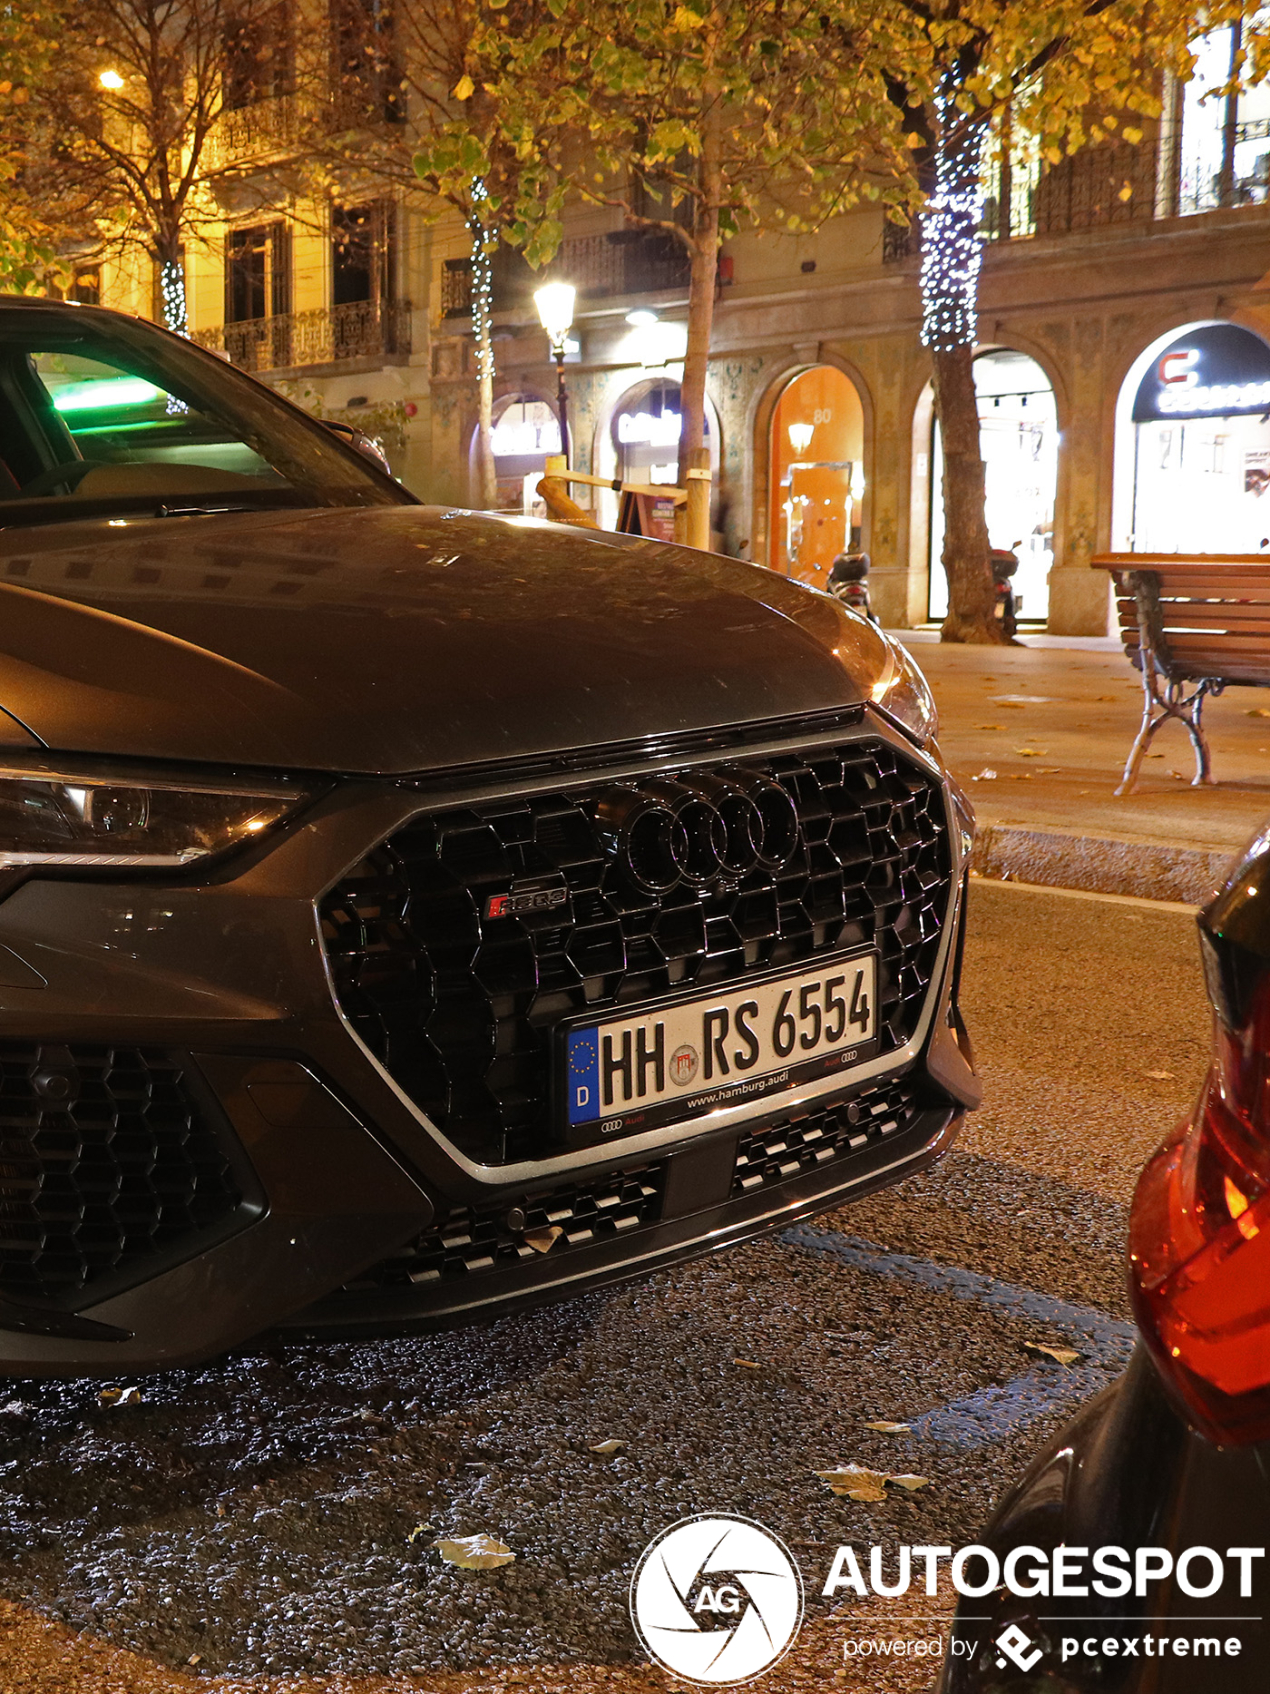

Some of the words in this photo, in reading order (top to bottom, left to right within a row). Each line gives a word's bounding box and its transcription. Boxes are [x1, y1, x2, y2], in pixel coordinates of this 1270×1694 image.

[813, 408, 832, 424] 80
[603, 1020, 665, 1106] HH
[704, 999, 759, 1080] RS
[772, 969, 870, 1058] 6554
[576, 1085, 590, 1107] D
[687, 1070, 789, 1108] www.hamburg.audi
[625, 1114, 645, 1125] Audi
